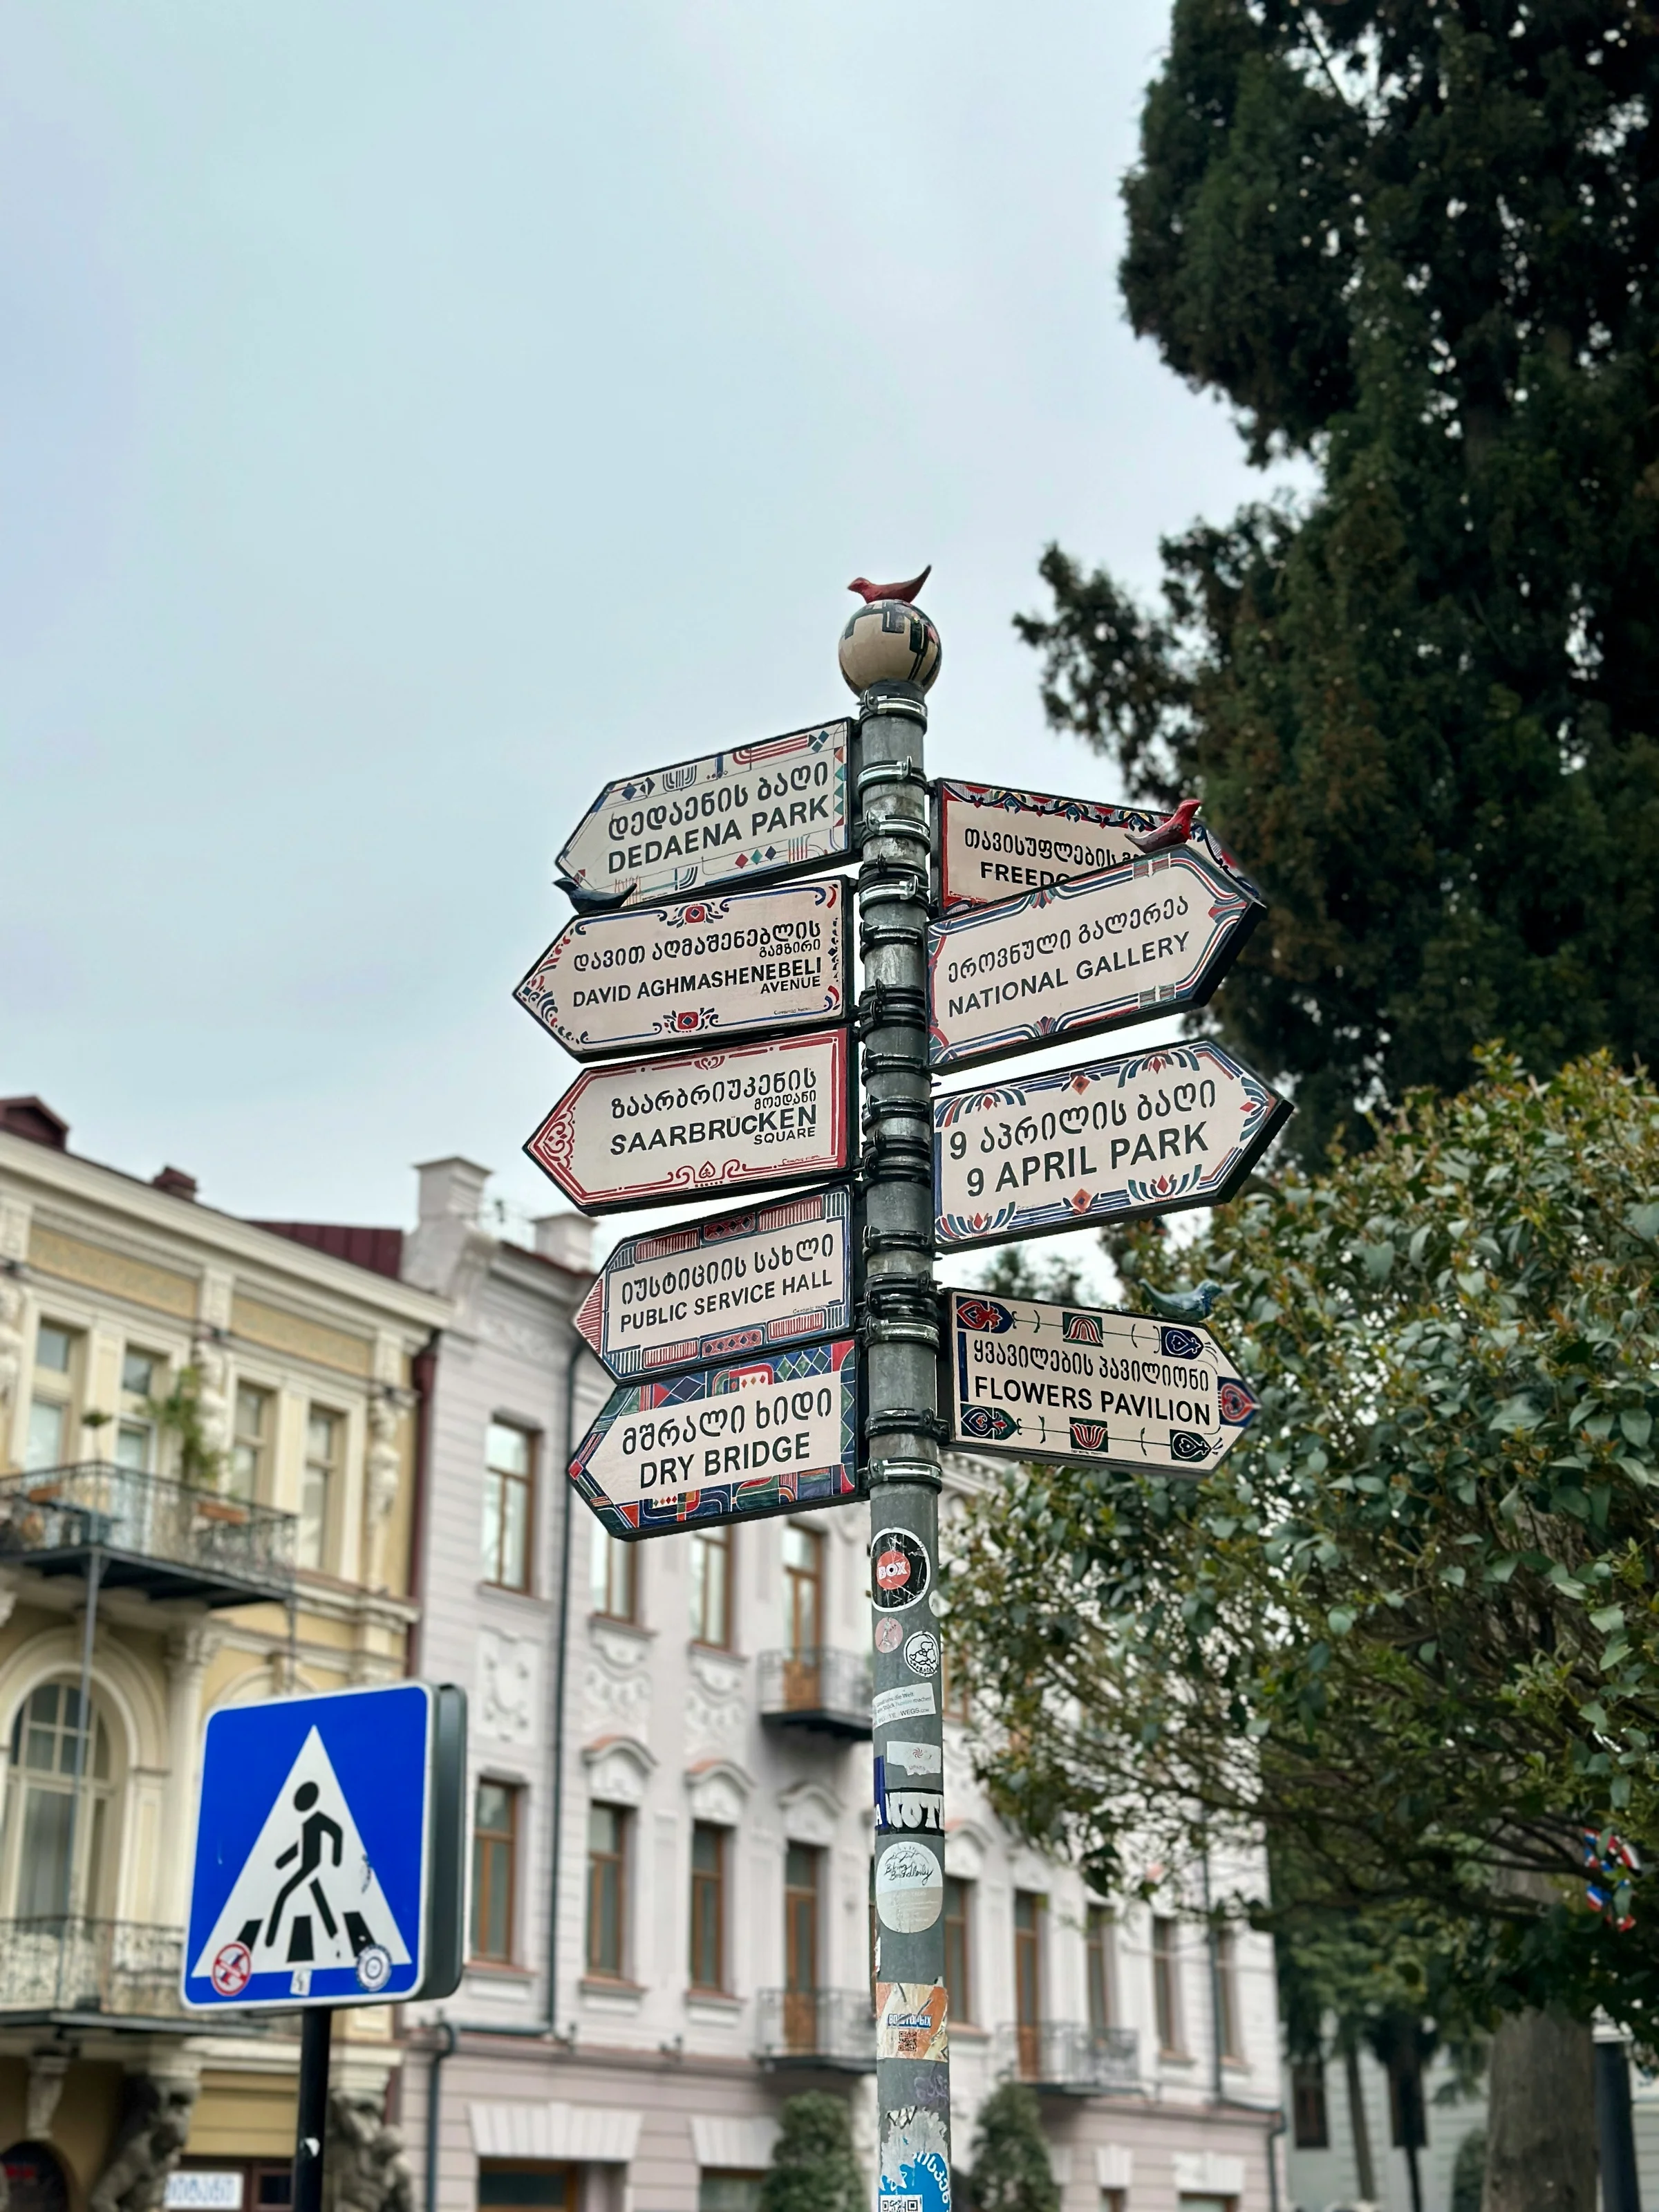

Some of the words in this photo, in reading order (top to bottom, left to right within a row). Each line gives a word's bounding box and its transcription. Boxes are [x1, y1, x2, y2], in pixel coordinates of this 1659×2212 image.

[609, 785, 748, 844] დედაენის
[758, 762, 827, 800] ბაღი
[609, 820, 742, 874] DEDAENA
[752, 794, 828, 836] PARK
[965, 828, 1116, 867] თავისუფლების
[574, 946, 645, 971] დავით
[653, 917, 821, 960] აღმაშენებლის
[760, 939, 820, 957] გამზირი
[949, 930, 1070, 982] ეროვნული
[1079, 896, 1188, 944] გალერეა
[574, 985, 630, 1007] DAVID
[637, 957, 821, 999] AGHMASHENEBELI
[760, 976, 821, 994] AVENUE
[949, 968, 1068, 1017] NATIONAL
[1076, 931, 1189, 979] GALLERY
[612, 1067, 816, 1118] ზაარბრიუკენის
[755, 1090, 816, 1110] მოედანი
[610, 1105, 816, 1155] SAARBRÜCKEN
[754, 1127, 815, 1145] SQUARE
[950, 1132, 966, 1159] 9
[981, 1100, 1126, 1152] აპრილის
[1138, 1080, 1215, 1121] ბაღი
[967, 1168, 984, 1197] 9
[995, 1146, 1096, 1192] APRIL
[1111, 1121, 1208, 1169] PARK
[622, 1257, 748, 1306] იუსტიციის
[755, 1234, 833, 1273] სახლი
[621, 1302, 687, 1332] PUBLIC
[694, 1282, 774, 1315] SERVICE
[783, 1270, 832, 1295] HALL
[974, 1340, 1093, 1376] ყვავილების
[1100, 1356, 1208, 1391] პავილიონი
[623, 1405, 744, 1454] მშრალი
[756, 1388, 831, 1429] ხიდი
[975, 1376, 1092, 1410] FLOWERS
[1101, 1391, 1210, 1425] PAVILION
[641, 1454, 694, 1488] DRY
[705, 1432, 809, 1477] BRIDGE
[878, 1561, 908, 1580] BOX
